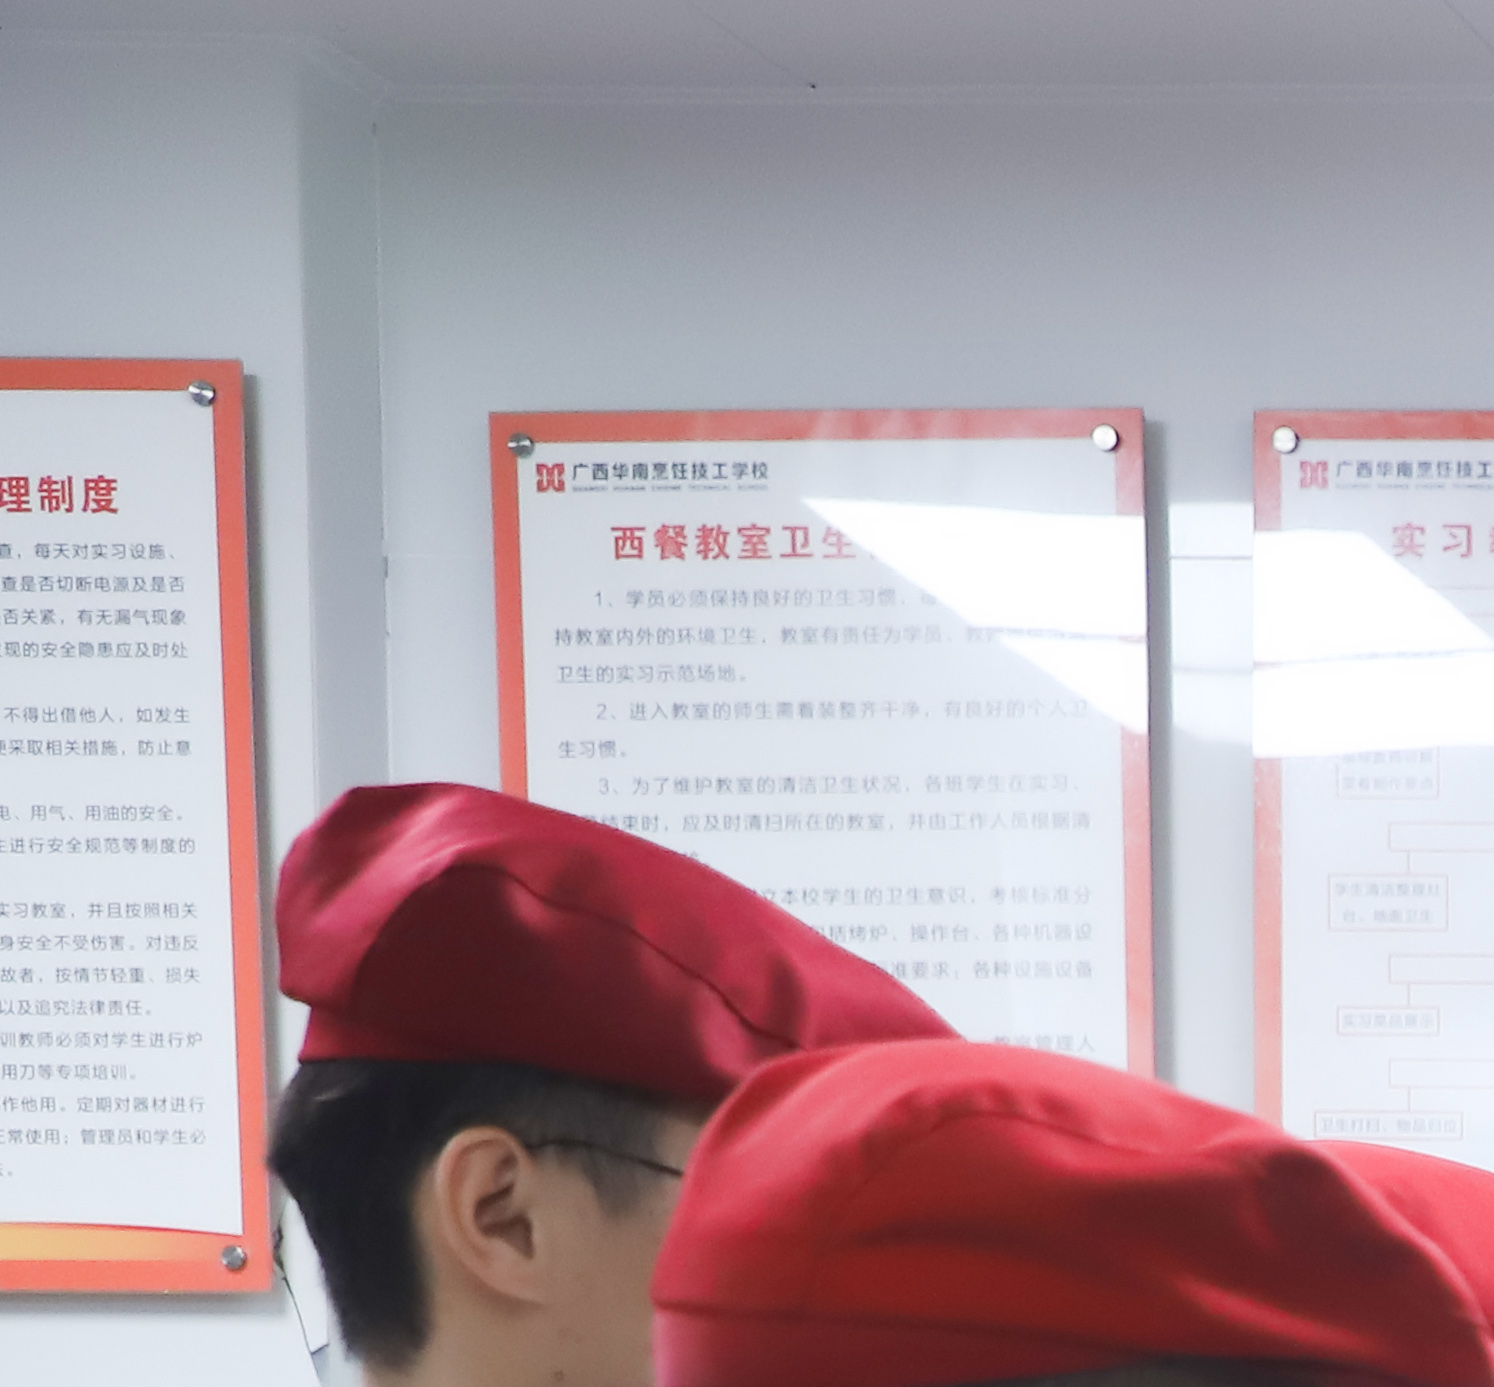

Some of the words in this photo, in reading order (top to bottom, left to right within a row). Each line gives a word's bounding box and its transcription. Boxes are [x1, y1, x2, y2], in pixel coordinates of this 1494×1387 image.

[572, 461, 769, 481] 广西华南烹饪技工学校
[611, 523, 877, 561] 西餐教室卫生
[0, 608, 187, 626] 否关紧，有无漏气现象
[0, 641, 188, 658] 现的安全隐患应及时处
[0, 836, 196, 854] 进行安全规范等制度的
